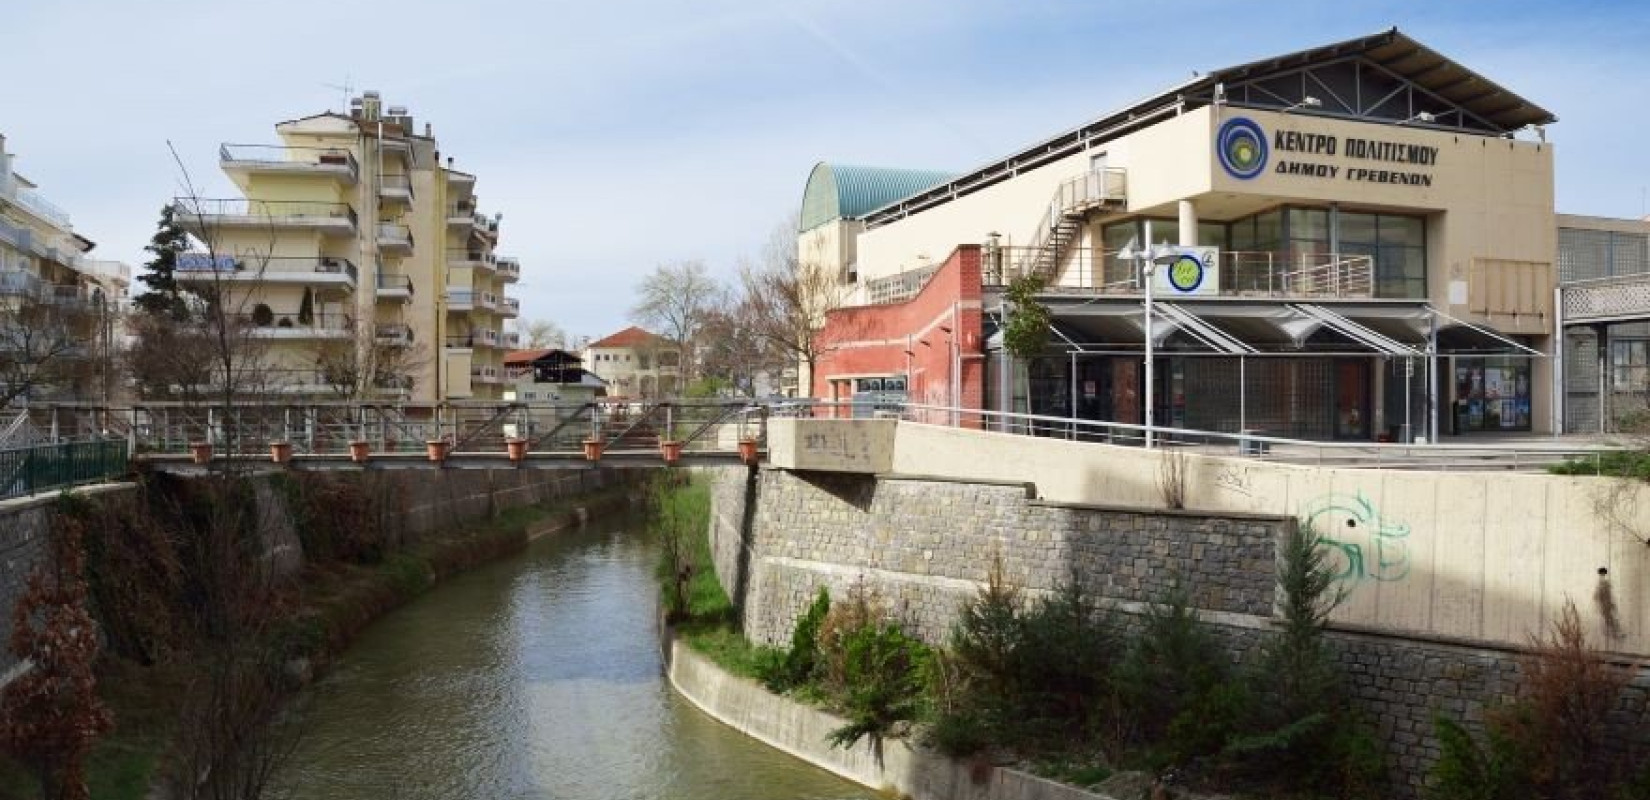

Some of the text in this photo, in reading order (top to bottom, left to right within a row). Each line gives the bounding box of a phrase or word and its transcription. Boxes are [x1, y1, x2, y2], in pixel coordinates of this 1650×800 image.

[1275, 129, 1438, 165] ΚΕΝΤΡΟ ΠΟΛΙΤΙΣΜΟΥ
[1275, 161, 1432, 186] ΔΗΜΟΥ ΓΡΕΒΕΝΩΝ
